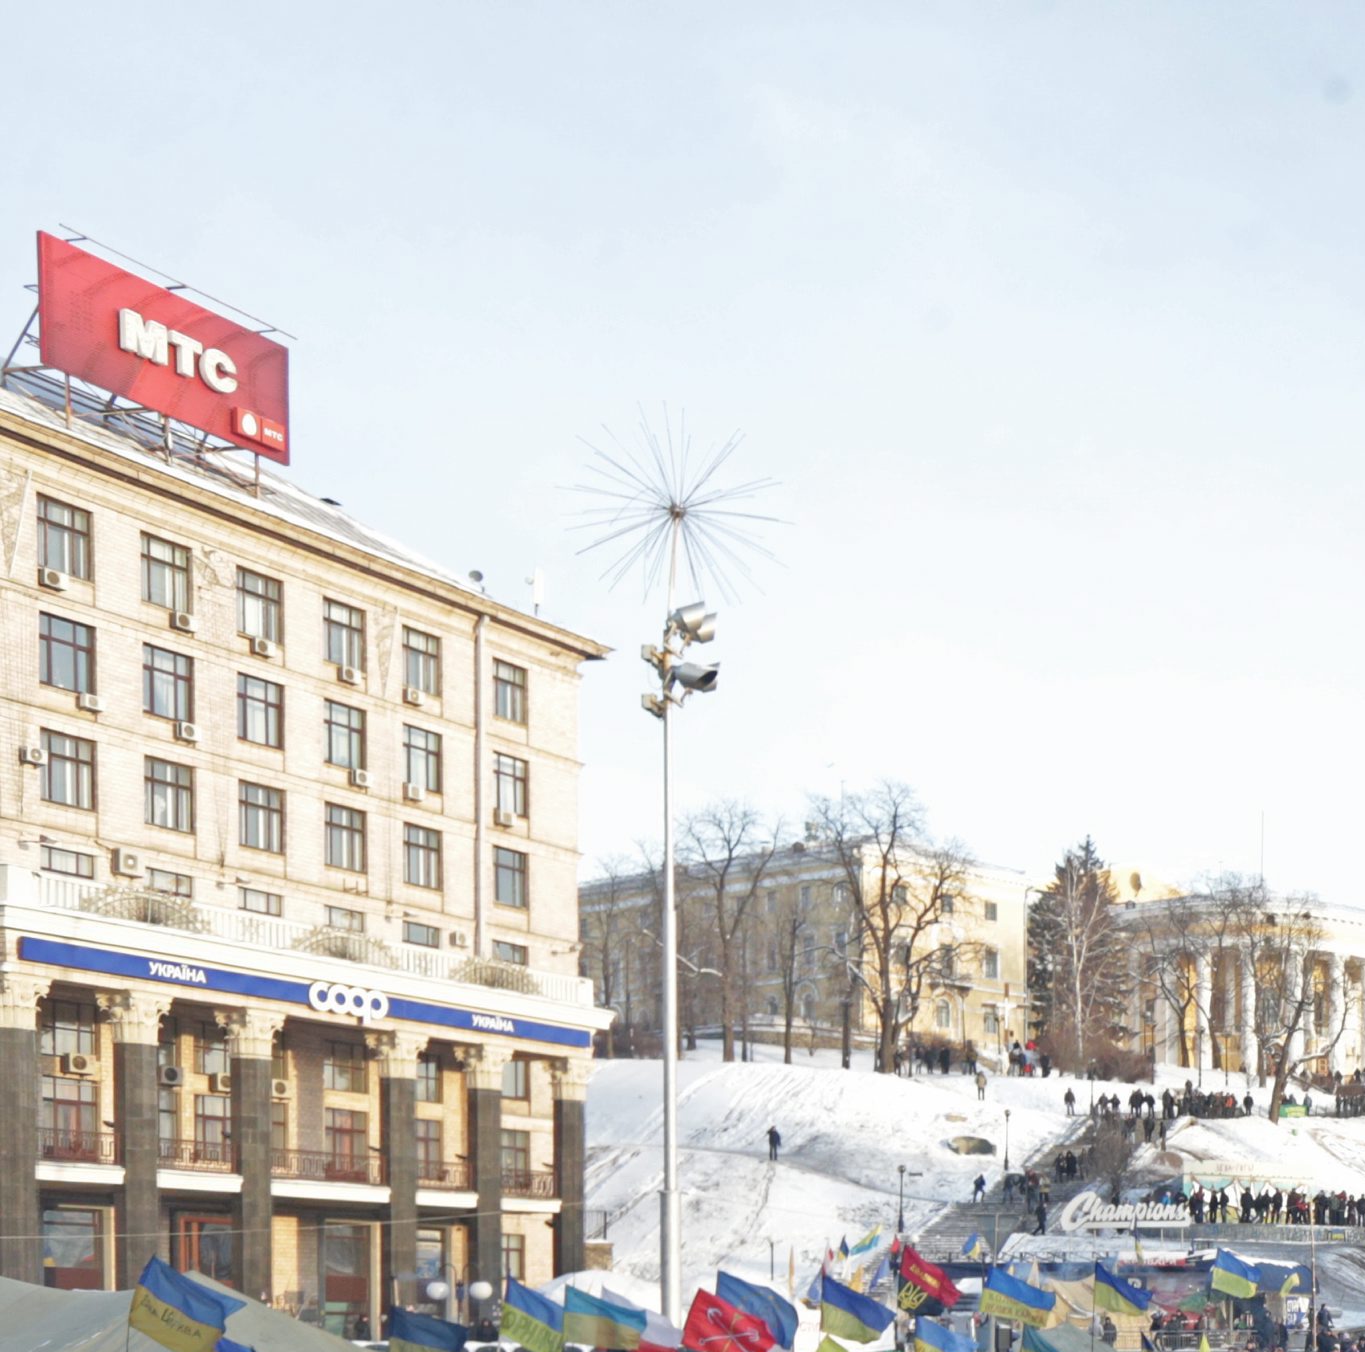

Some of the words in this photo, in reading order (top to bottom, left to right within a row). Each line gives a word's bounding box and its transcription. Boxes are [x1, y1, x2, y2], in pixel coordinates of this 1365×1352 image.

[118, 308, 239, 394] МТС
[263, 426, 285, 443] МТС
[149, 961, 207, 985] УКРАЇНА
[471, 1013, 514, 1034] УКРАЇНА
[1060, 1191, 1191, 1232] Champions
